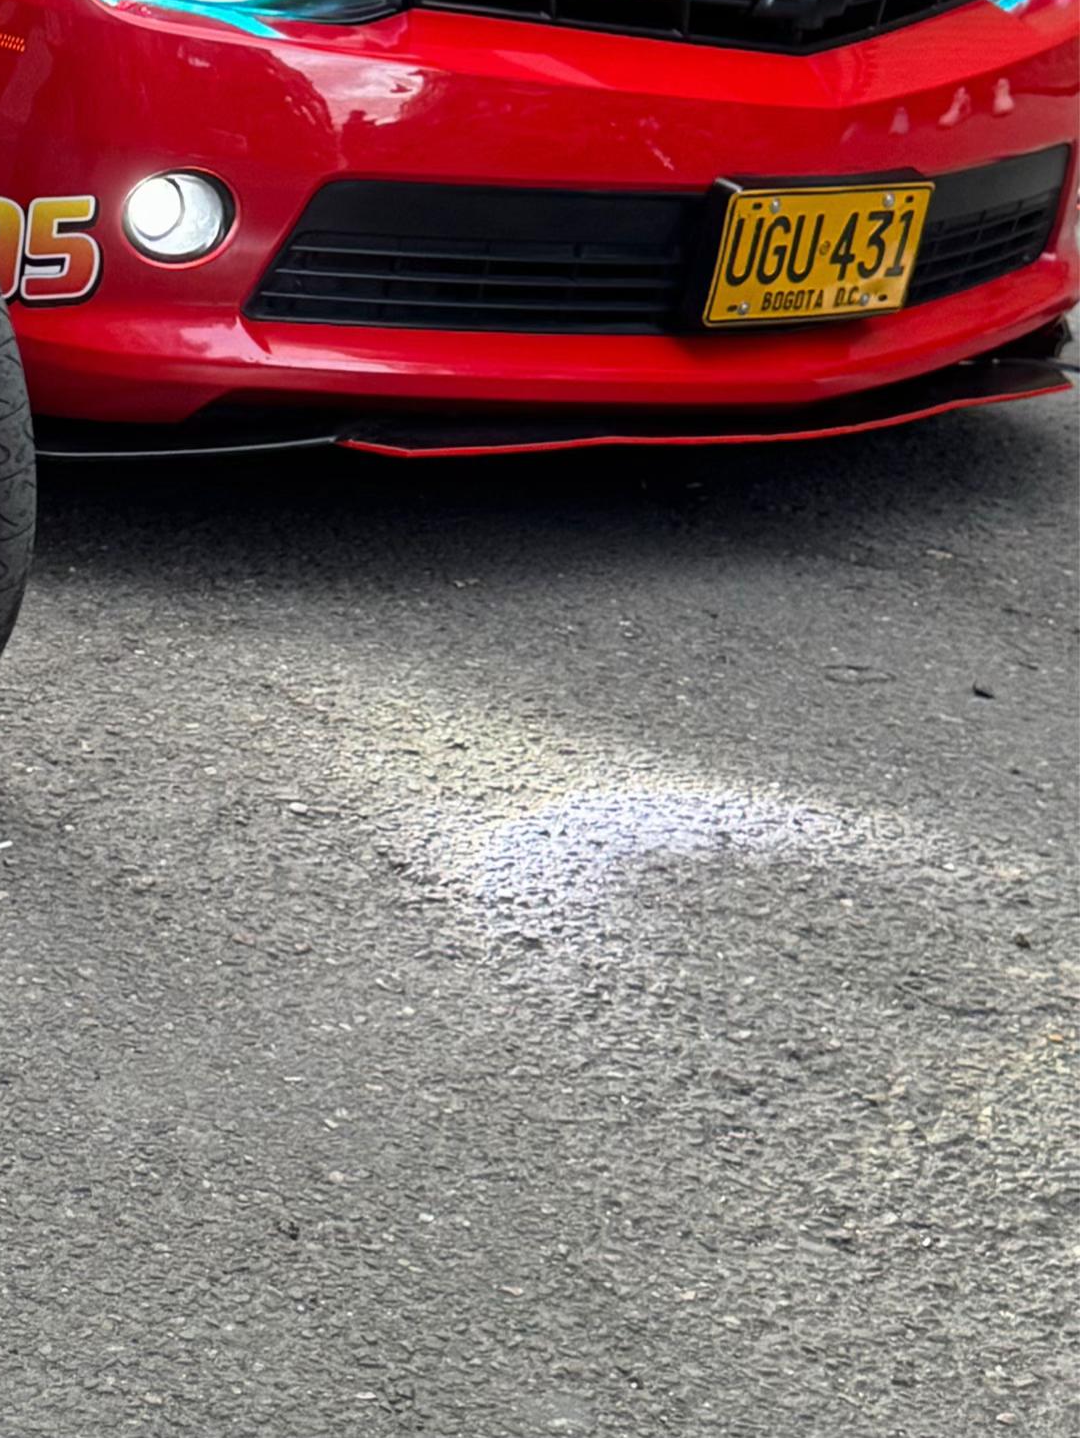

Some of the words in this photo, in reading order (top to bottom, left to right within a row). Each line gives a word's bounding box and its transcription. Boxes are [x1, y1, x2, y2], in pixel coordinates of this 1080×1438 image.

[724, 213, 825, 287] UGU
[828, 208, 915, 282] 431
[760, 288, 824, 313] BOGOTA
